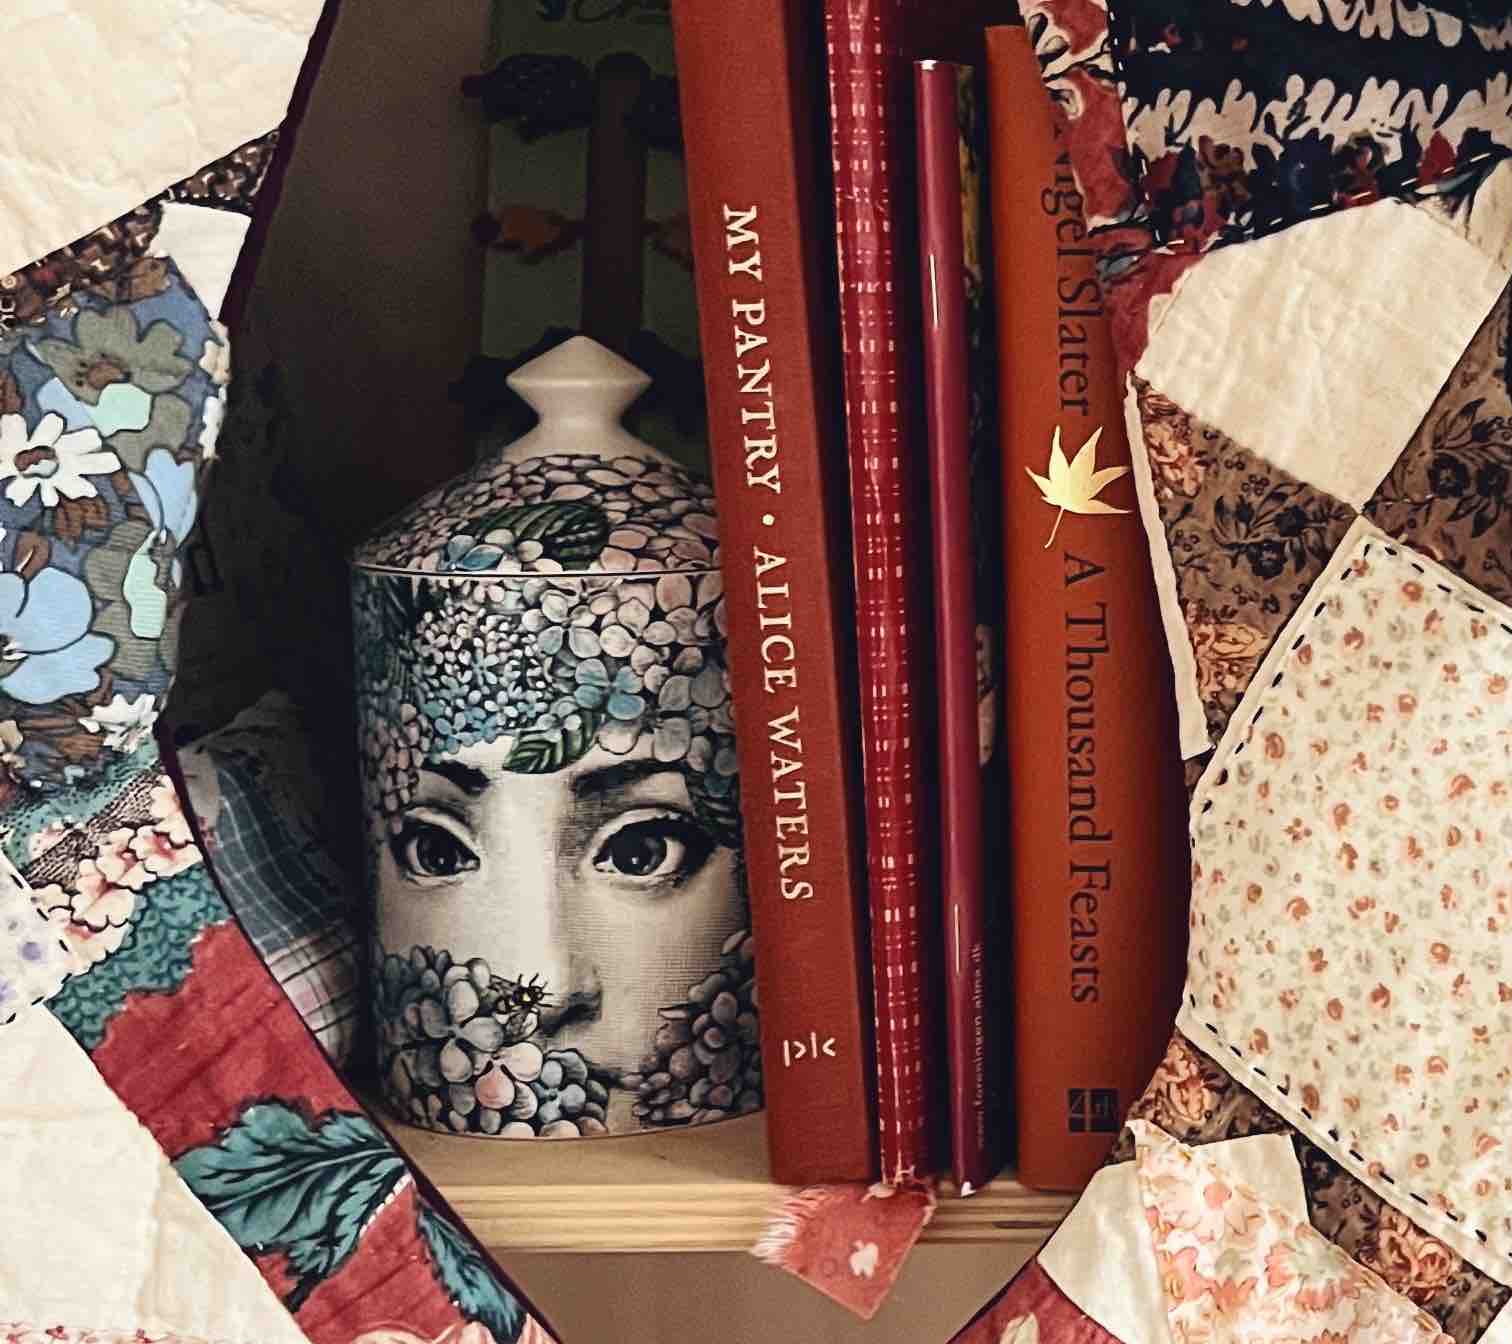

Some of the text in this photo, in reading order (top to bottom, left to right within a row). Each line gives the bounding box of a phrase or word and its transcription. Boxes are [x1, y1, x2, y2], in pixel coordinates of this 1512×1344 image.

[723, 203, 814, 901] MY PANTRY ALICE WATERS
[1056, 277, 1104, 417] Slater
[1065, 552, 1113, 1005] A Thousand Feasts
